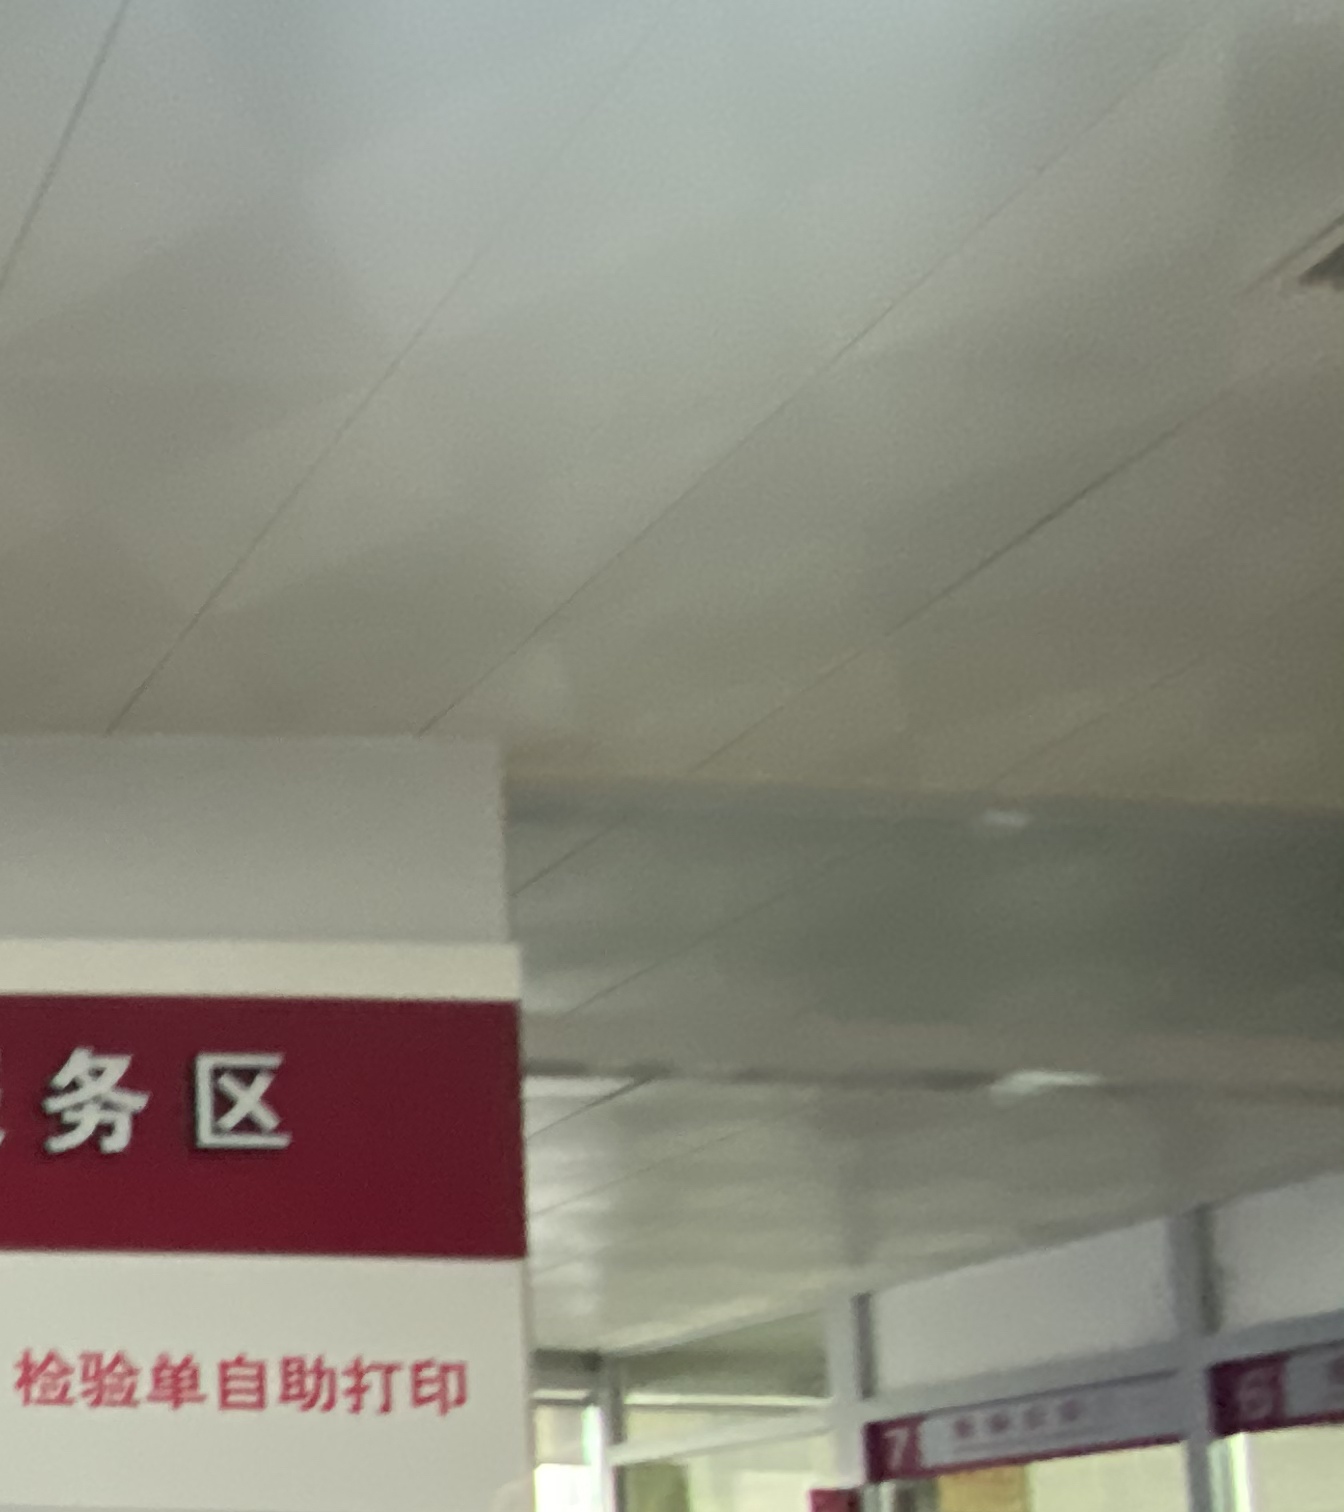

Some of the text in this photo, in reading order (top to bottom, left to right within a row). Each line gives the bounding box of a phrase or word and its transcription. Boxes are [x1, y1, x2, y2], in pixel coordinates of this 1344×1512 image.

[12, 1346, 470, 1418] 检验单自助打印
[883, 1424, 912, 1472] 7
